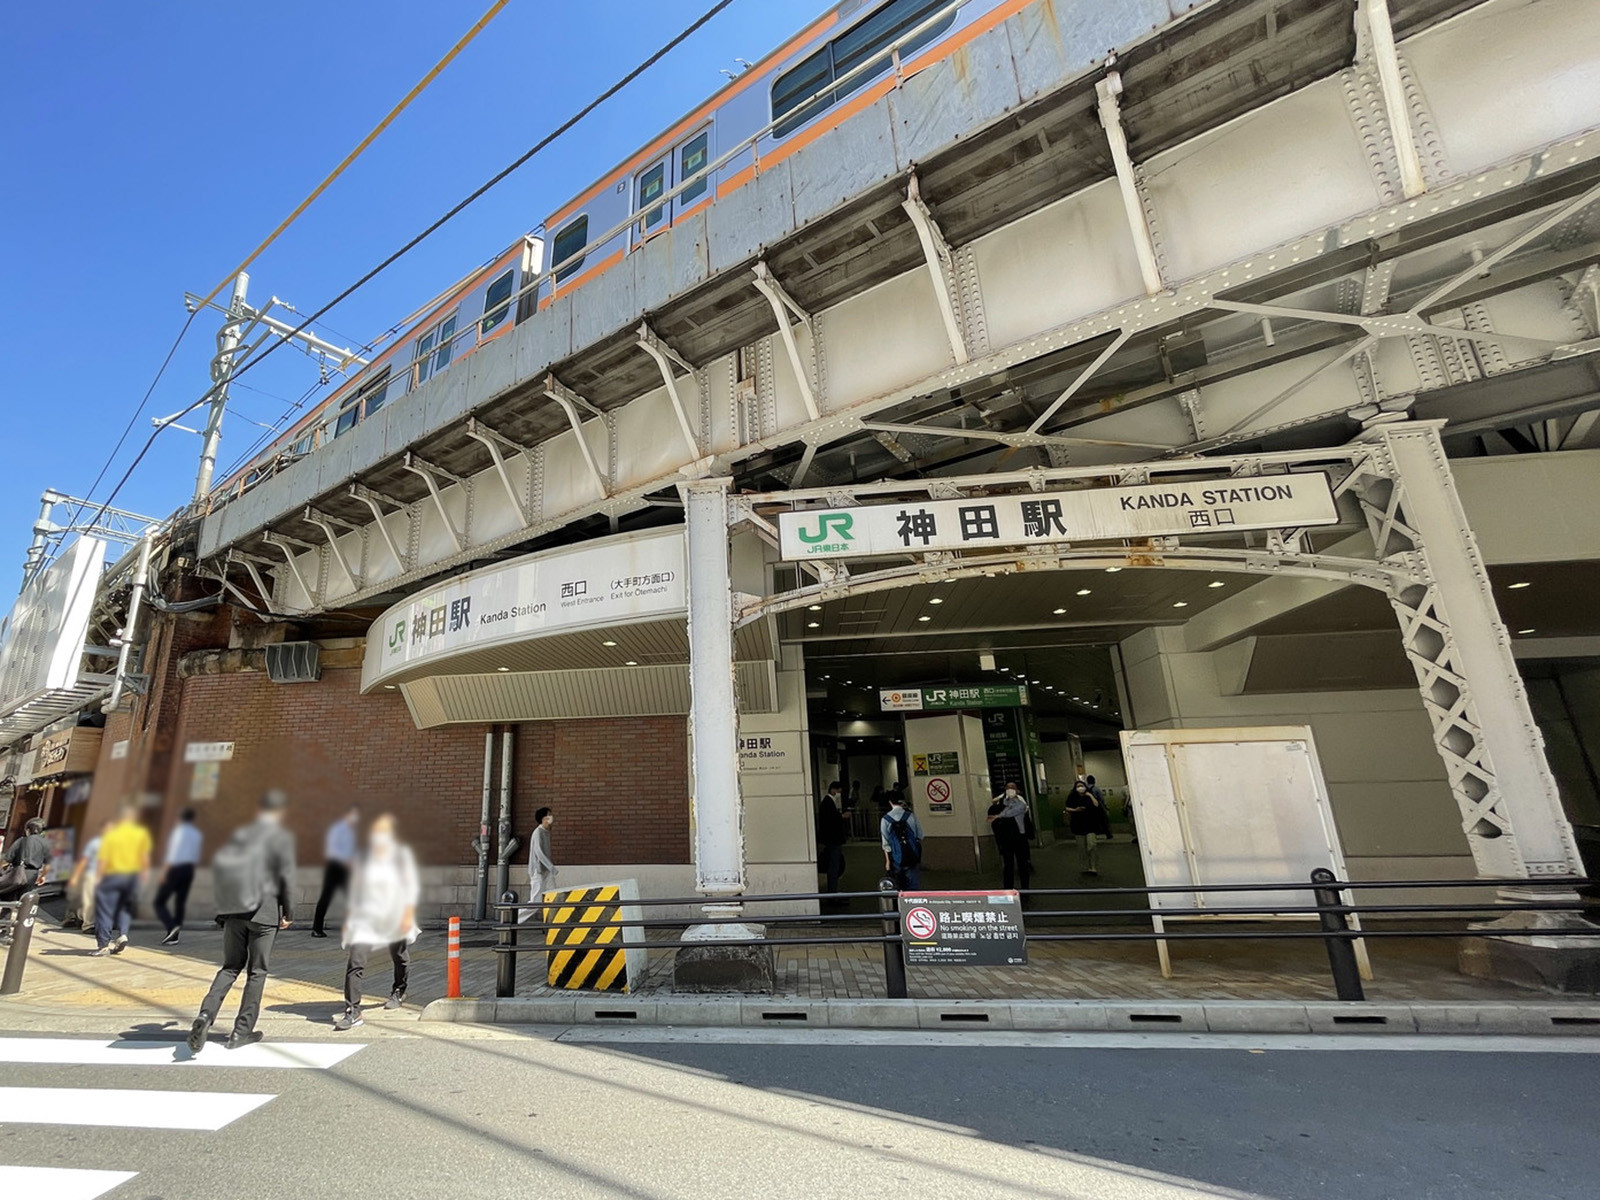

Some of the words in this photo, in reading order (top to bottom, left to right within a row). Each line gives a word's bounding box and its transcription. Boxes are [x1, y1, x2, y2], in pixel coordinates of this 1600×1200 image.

[1120, 492, 1194, 510] KANDA
[1202, 485, 1293, 505] STATION
[896, 499, 1068, 546] 神田駅
[1188, 508, 1235, 528] 西口
[798, 512, 855, 543] JR
[807, 543, 850, 554] JR東日本
[561, 580, 587, 598] 西口
[610, 592, 623, 600] Exit
[624, 589, 633, 598] for
[561, 600, 576, 608] West
[577, 595, 604, 606] Entrance
[480, 610, 508, 625] Kanda
[511, 602, 547, 618] Station
[412, 596, 471, 646] 神田駅
[389, 619, 406, 648] JR
[925, 690, 947, 702] JR
[949, 688, 980, 699] 神田駅
[988, 713, 1005, 723] JR
[759, 750, 785, 758] Station
[929, 754, 942, 762] JR
[939, 911, 1009, 923] 路上喫煙禁止
